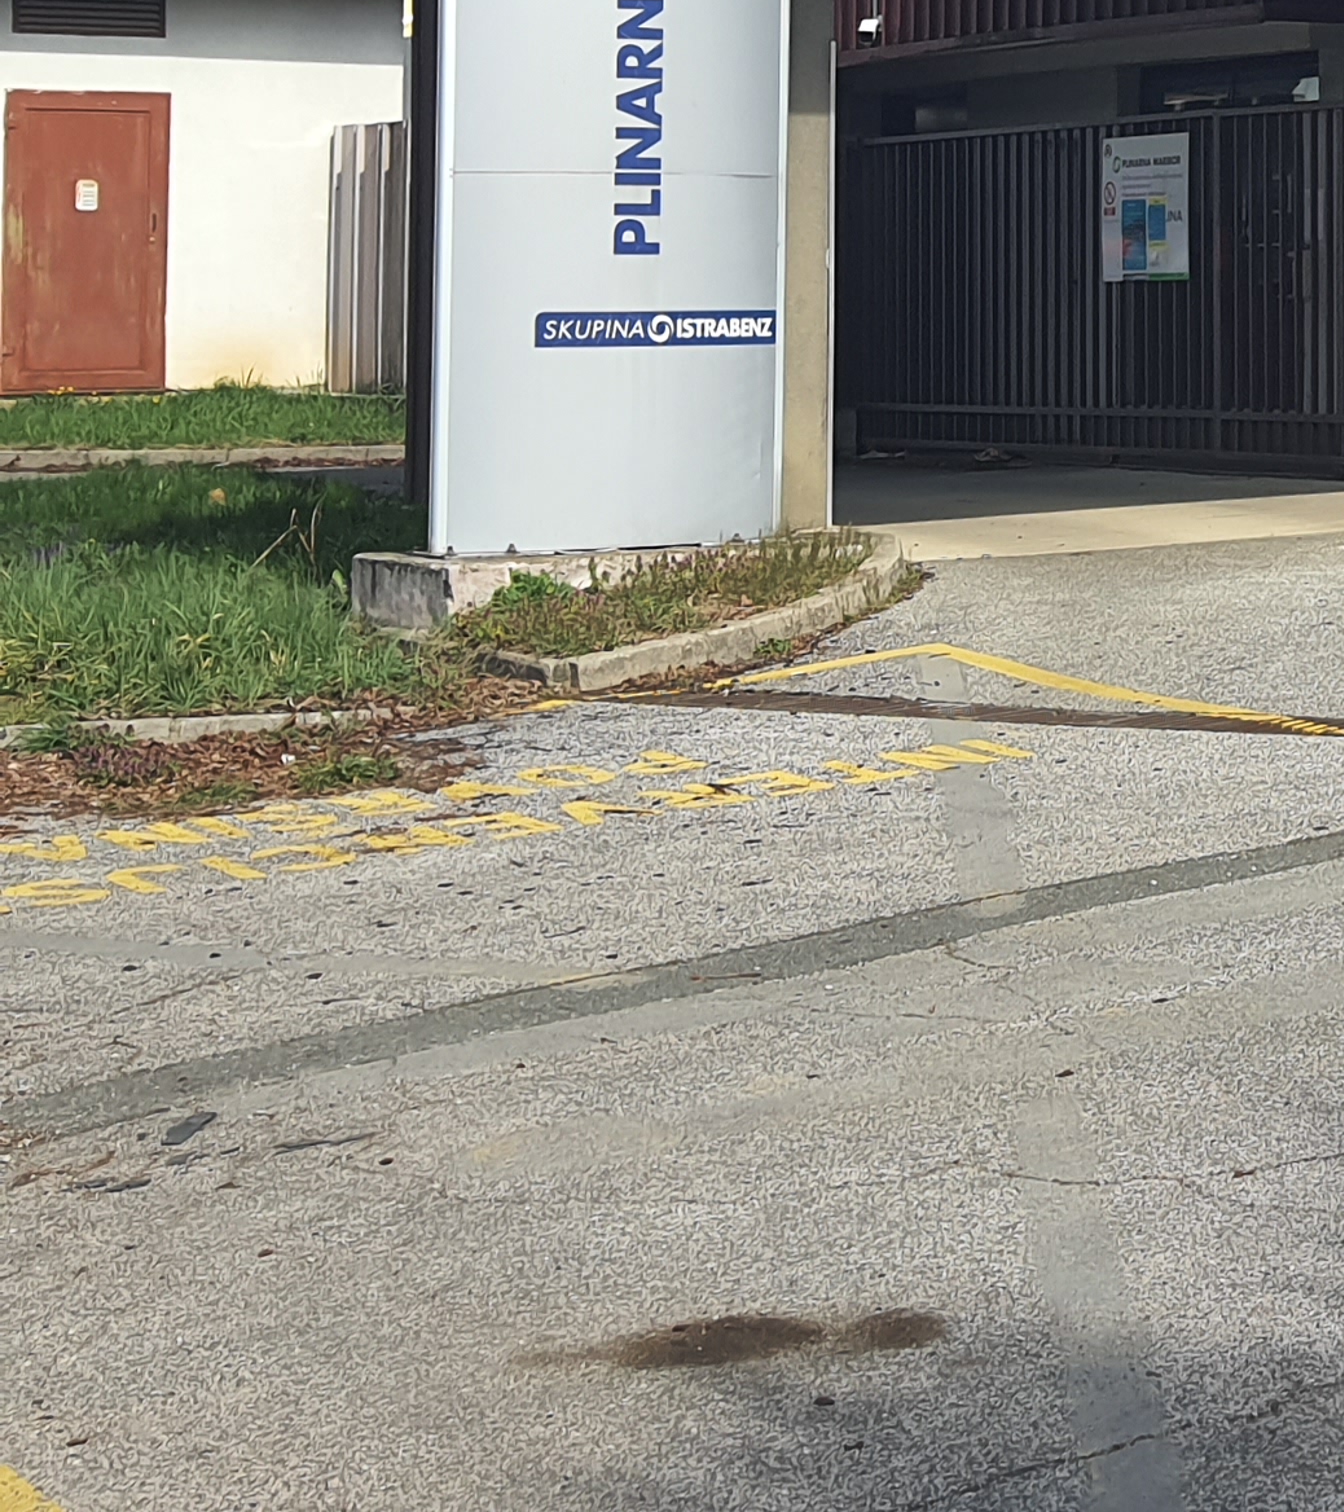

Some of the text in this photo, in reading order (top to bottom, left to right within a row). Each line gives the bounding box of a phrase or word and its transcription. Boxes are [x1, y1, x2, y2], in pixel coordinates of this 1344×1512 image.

[543, 317, 773, 340] SKUPINA ISTRABENZ
[0, 739, 1037, 915] INTERVENCIJS
